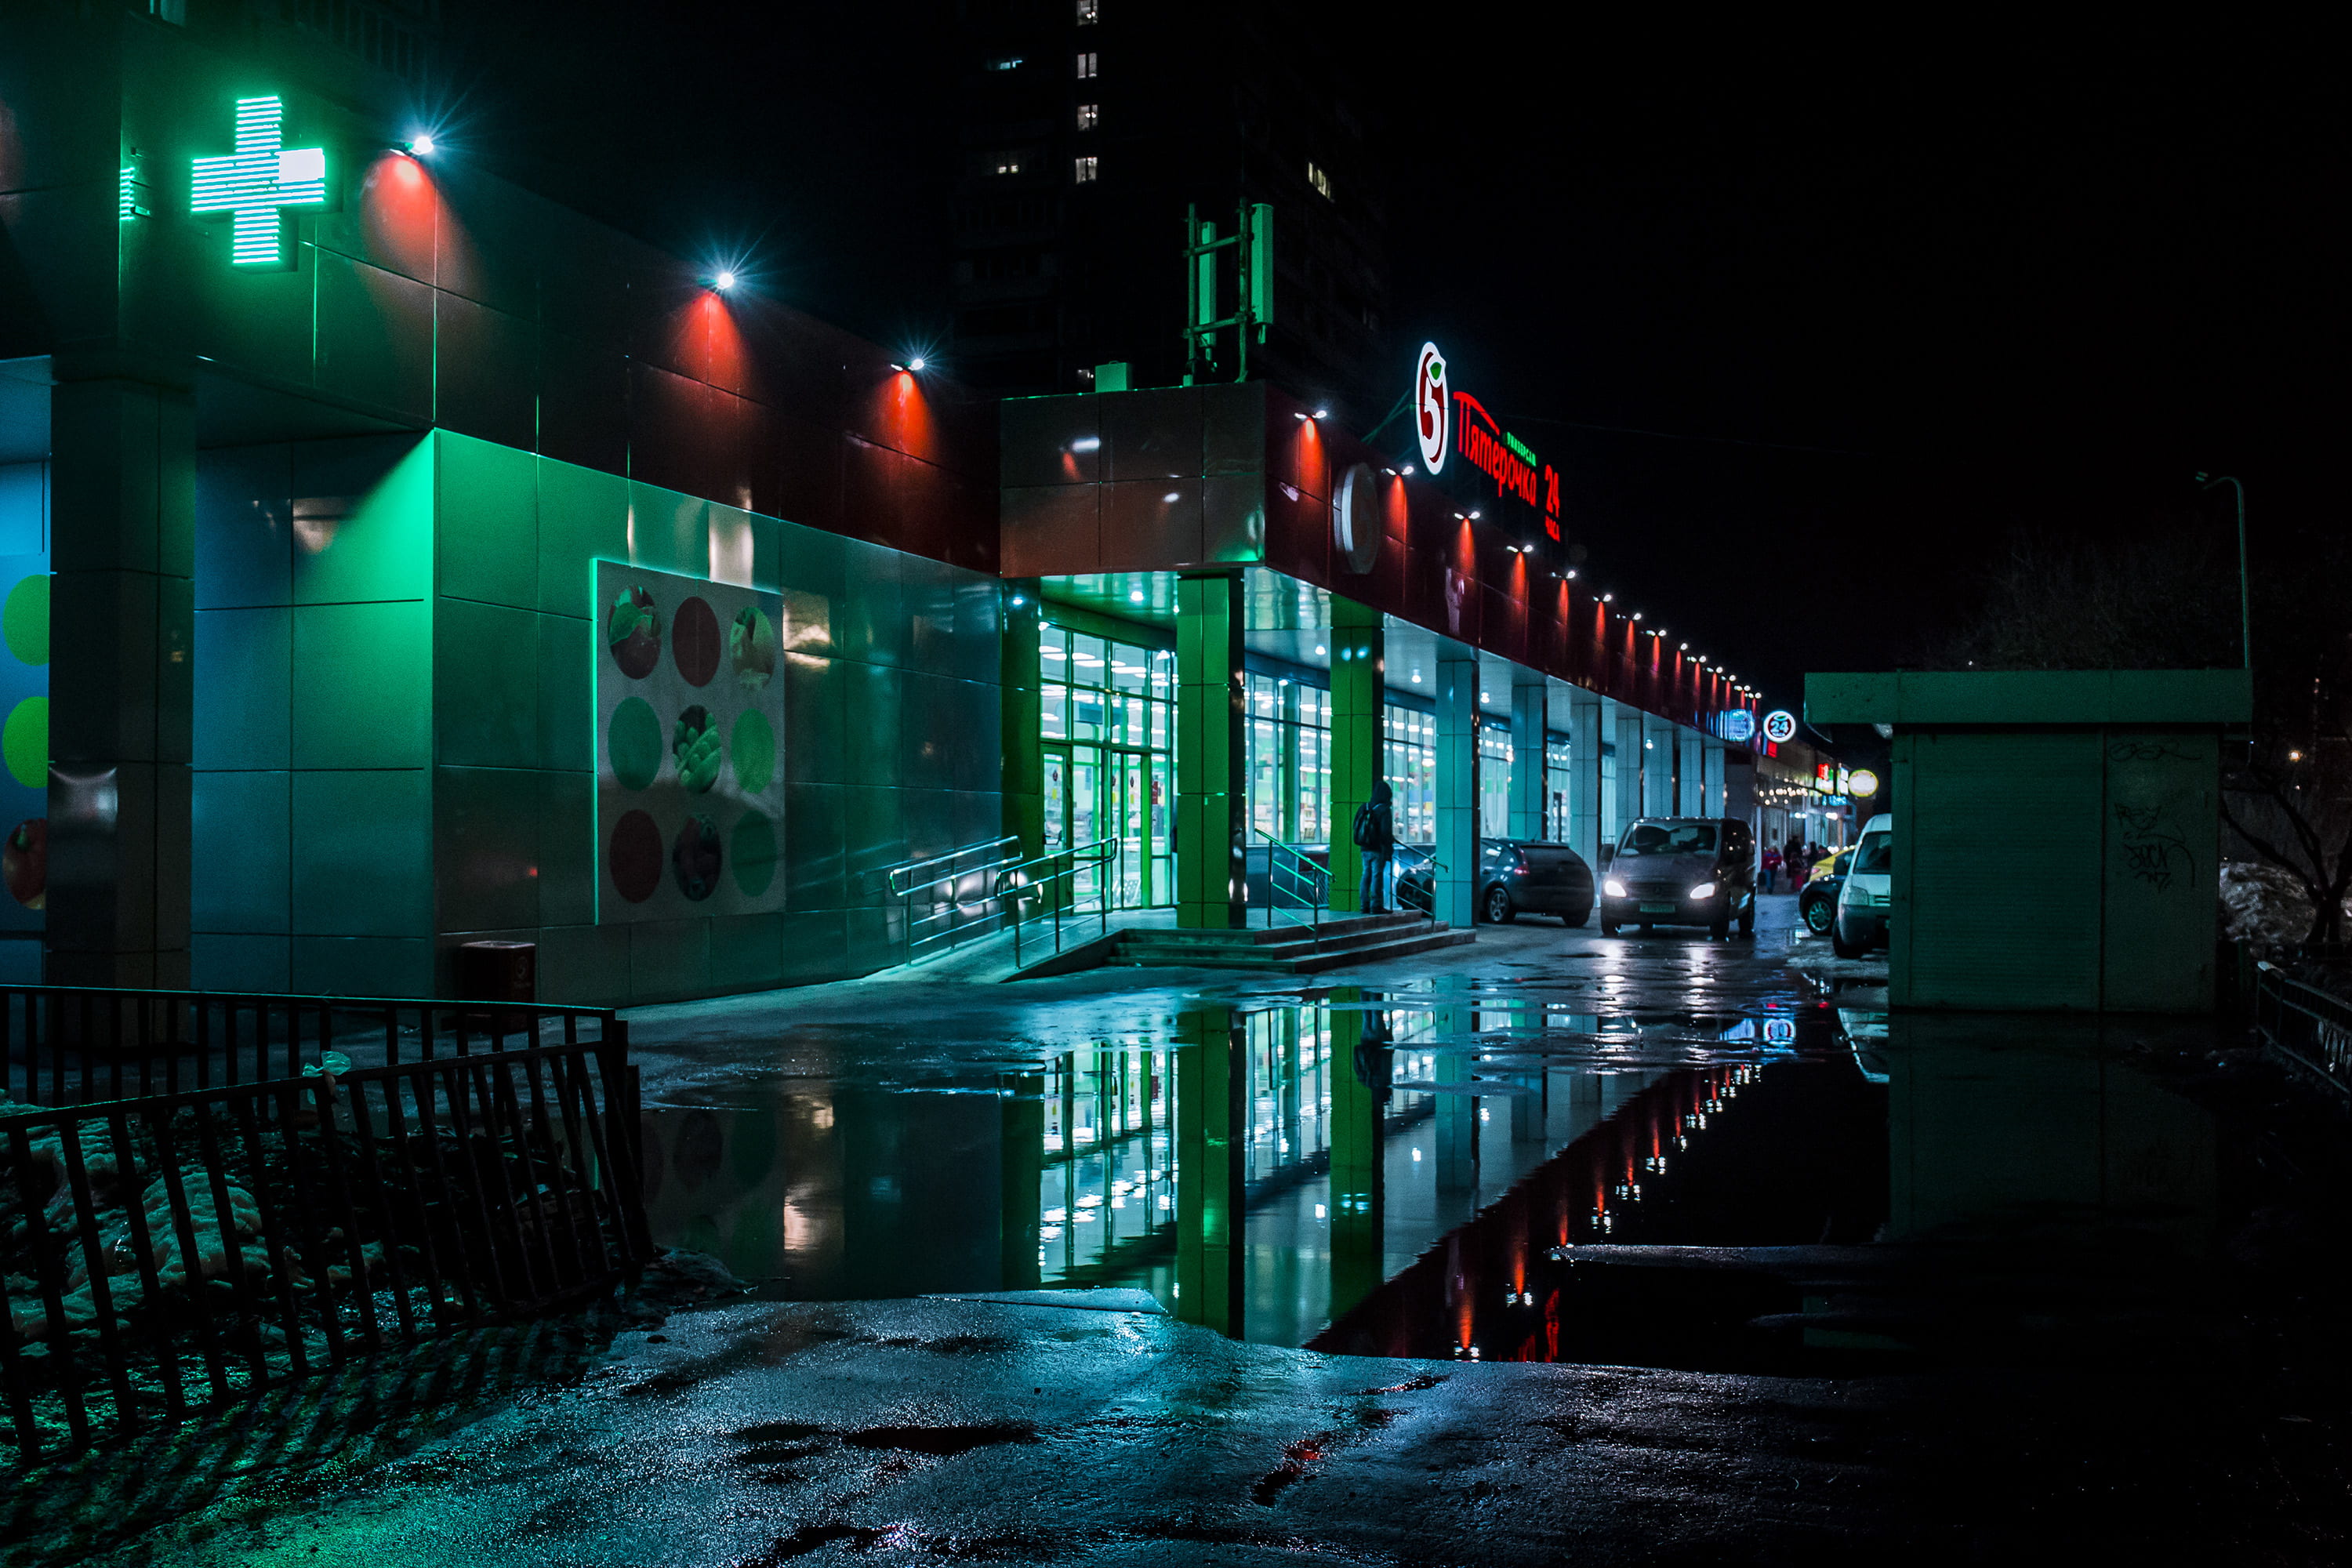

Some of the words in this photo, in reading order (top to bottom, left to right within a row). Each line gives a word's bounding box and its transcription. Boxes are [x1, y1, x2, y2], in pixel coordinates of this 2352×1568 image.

[1453, 391, 1537, 507] Пятерочка
[1544, 464, 1560, 517] 24
[1769, 720, 1789, 734] 24
